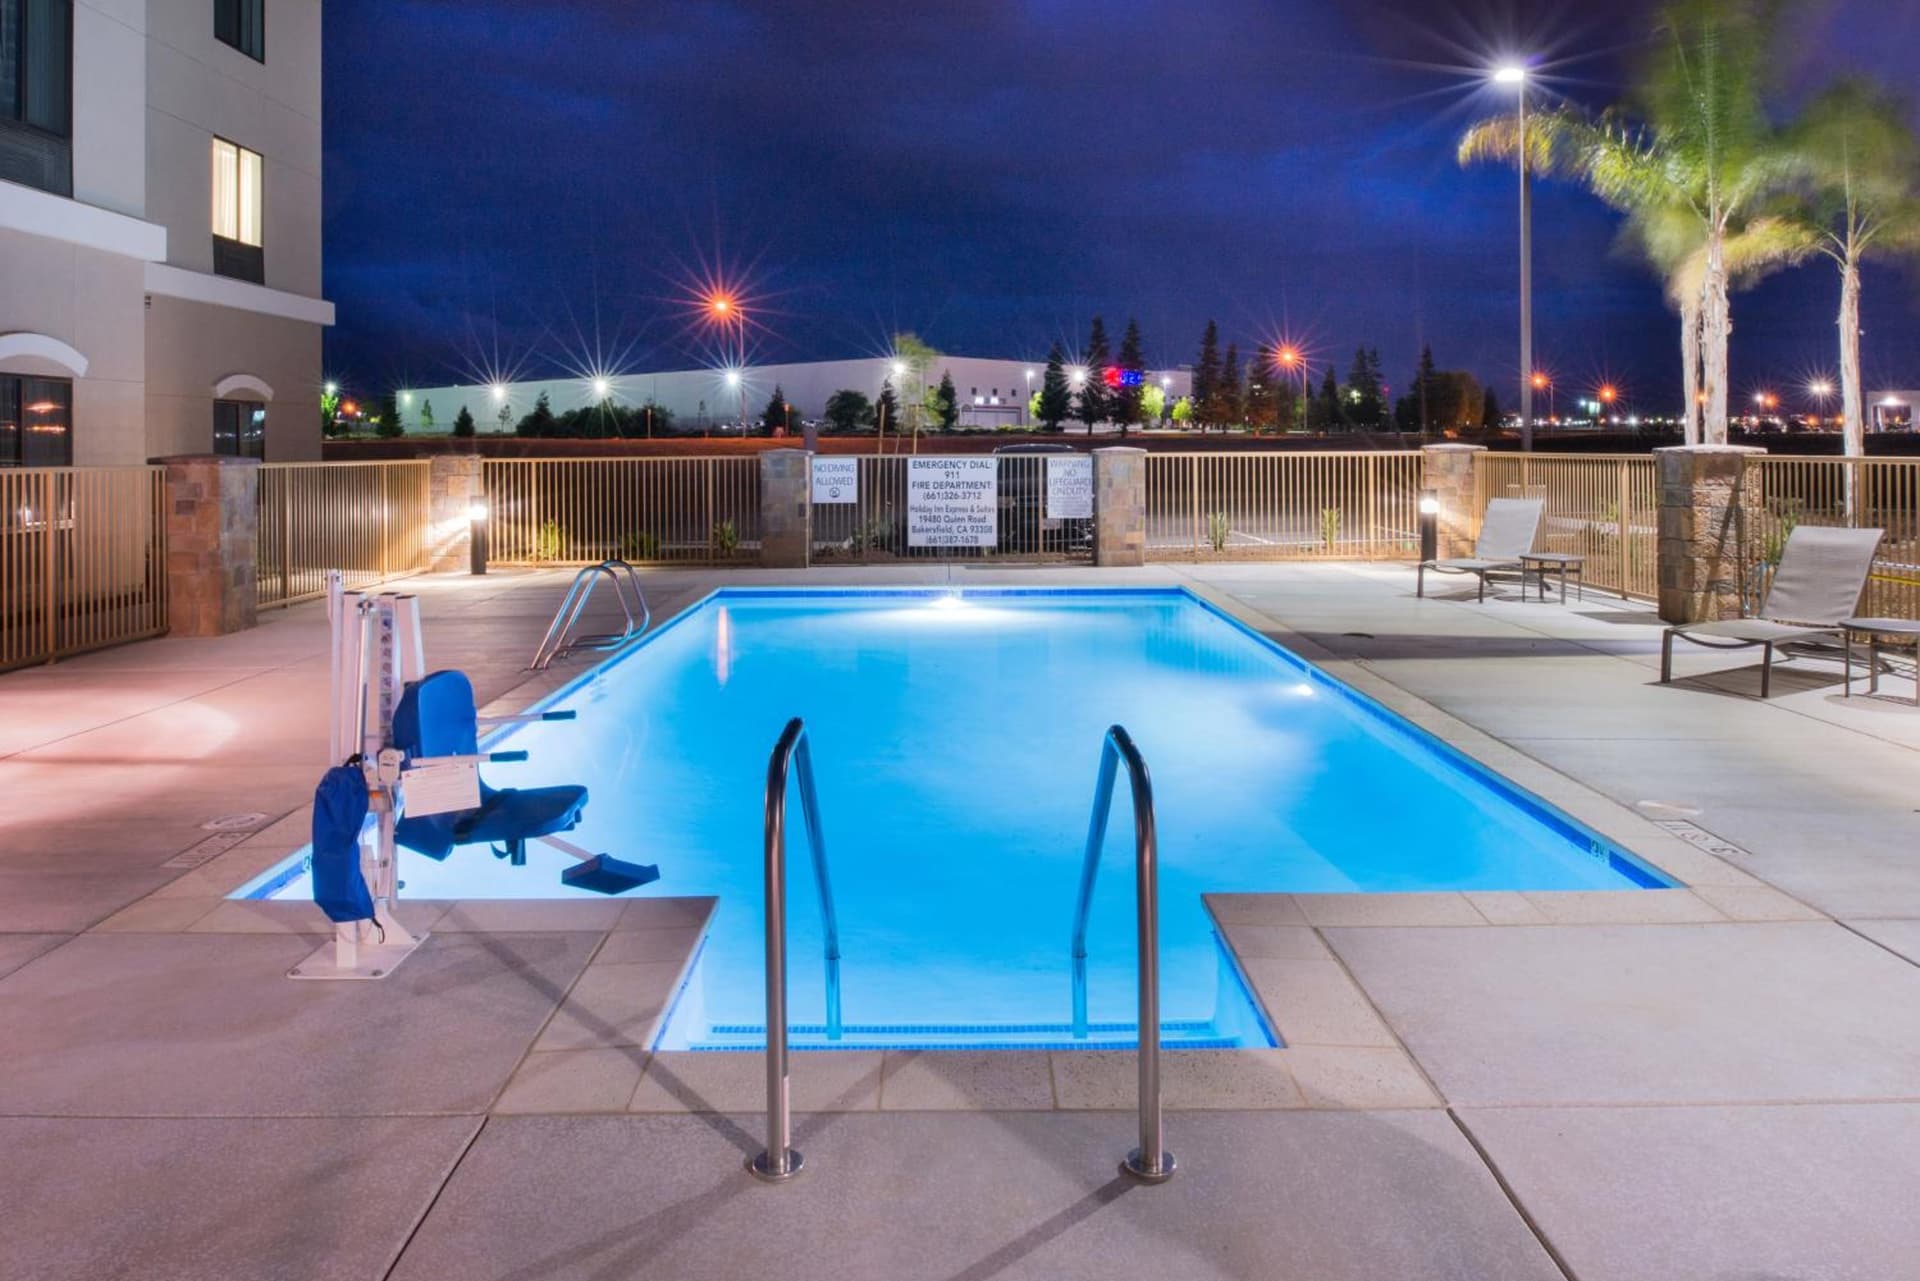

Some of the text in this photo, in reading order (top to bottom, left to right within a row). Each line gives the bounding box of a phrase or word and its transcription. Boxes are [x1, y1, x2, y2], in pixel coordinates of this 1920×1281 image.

[912, 460, 967, 470] EMERGENCY
[944, 470, 960, 479] 911
[815, 476, 854, 486] ALLOWED
[912, 481, 930, 490] FIRE
[967, 514, 987, 523] Road
[956, 525, 968, 534] CA
